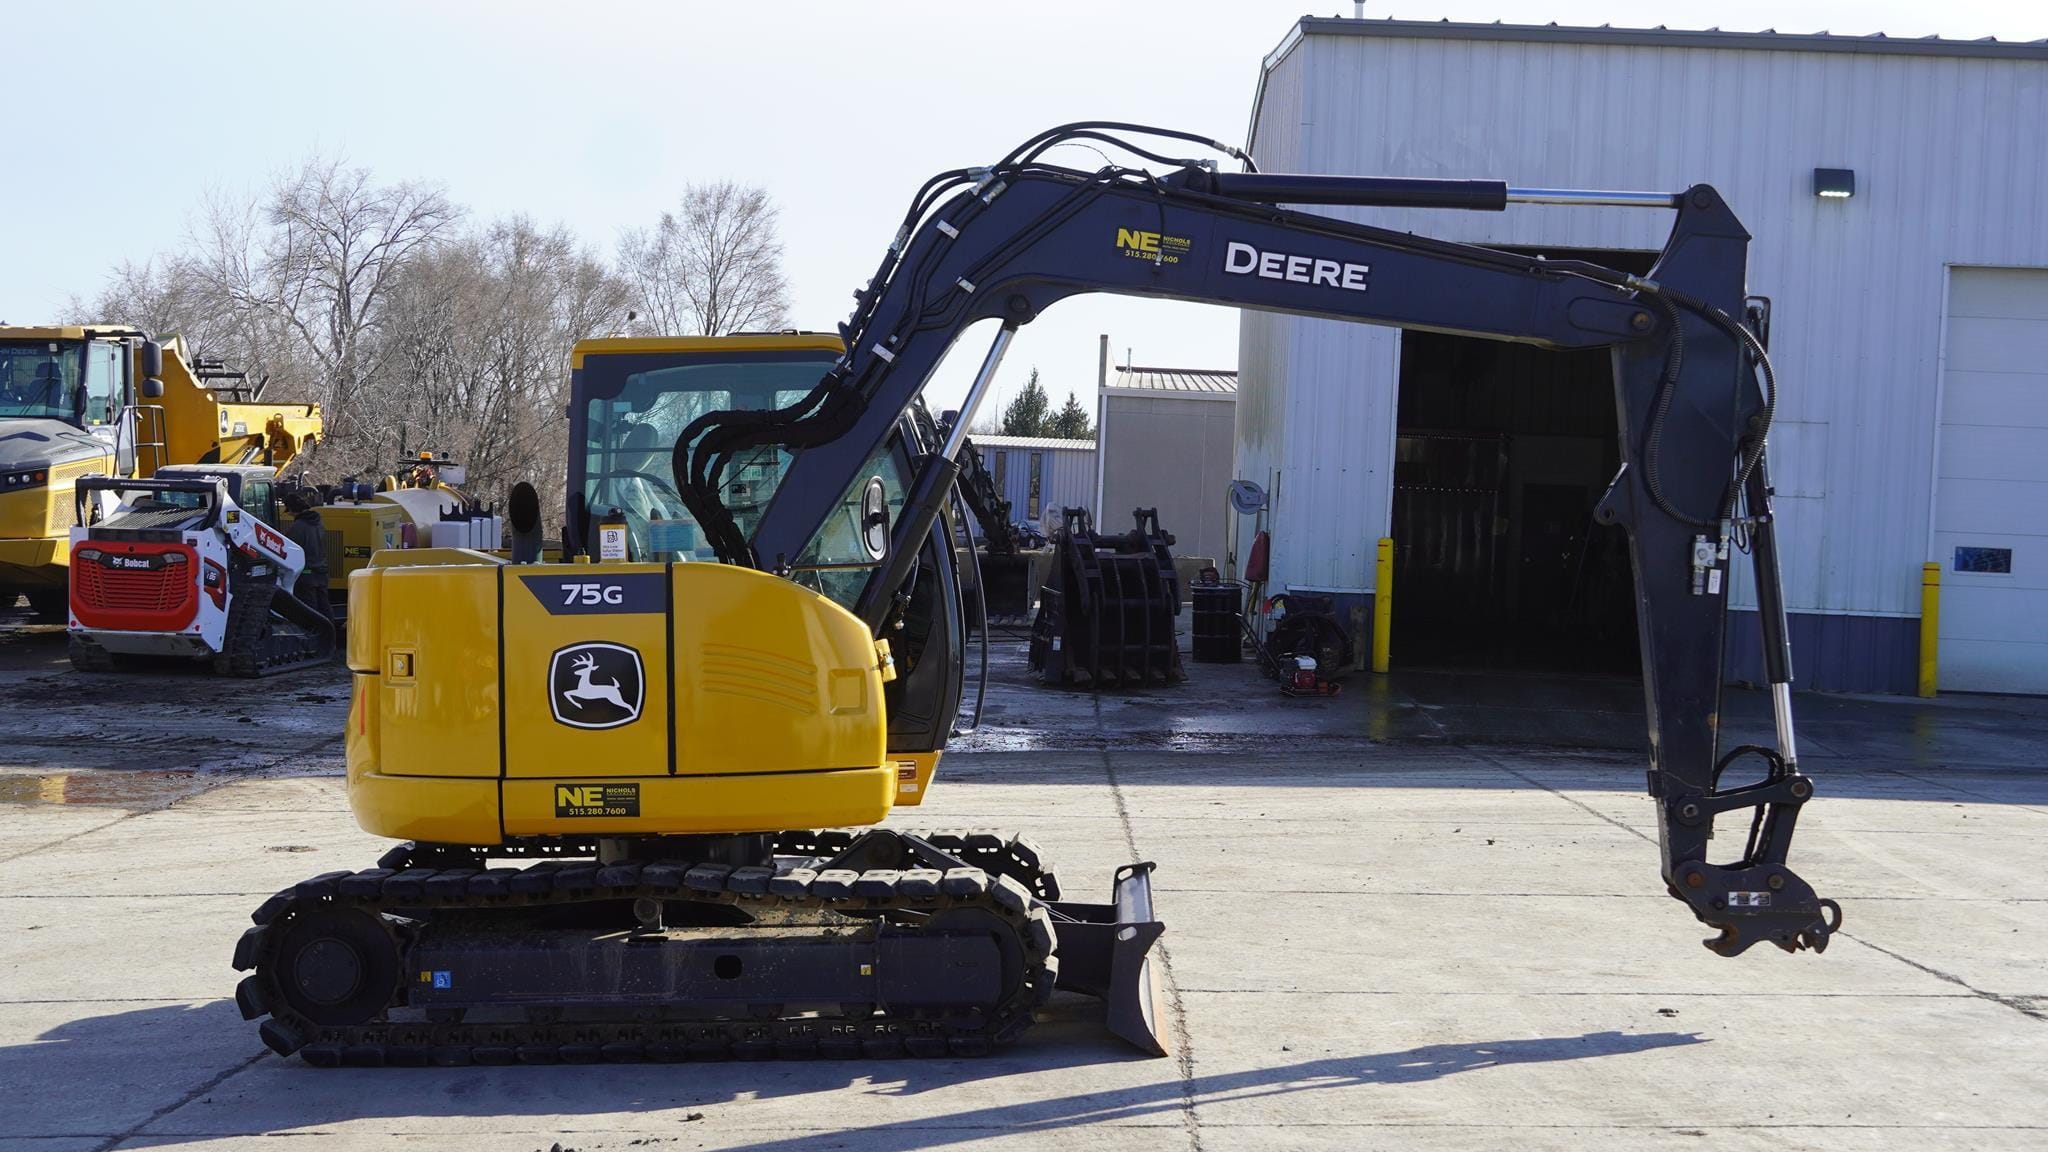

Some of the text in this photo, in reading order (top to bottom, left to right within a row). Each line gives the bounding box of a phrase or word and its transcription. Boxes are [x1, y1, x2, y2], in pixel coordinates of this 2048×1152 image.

[1117, 228, 1161, 252] NE
[1225, 241, 1369, 291] DEERE
[344, 547, 360, 555] NE
[124, 558, 150, 568] Bobcat
[561, 583, 623, 605] 75G
[558, 787, 604, 807] NE
[568, 807, 627, 816] 515.280.7600
